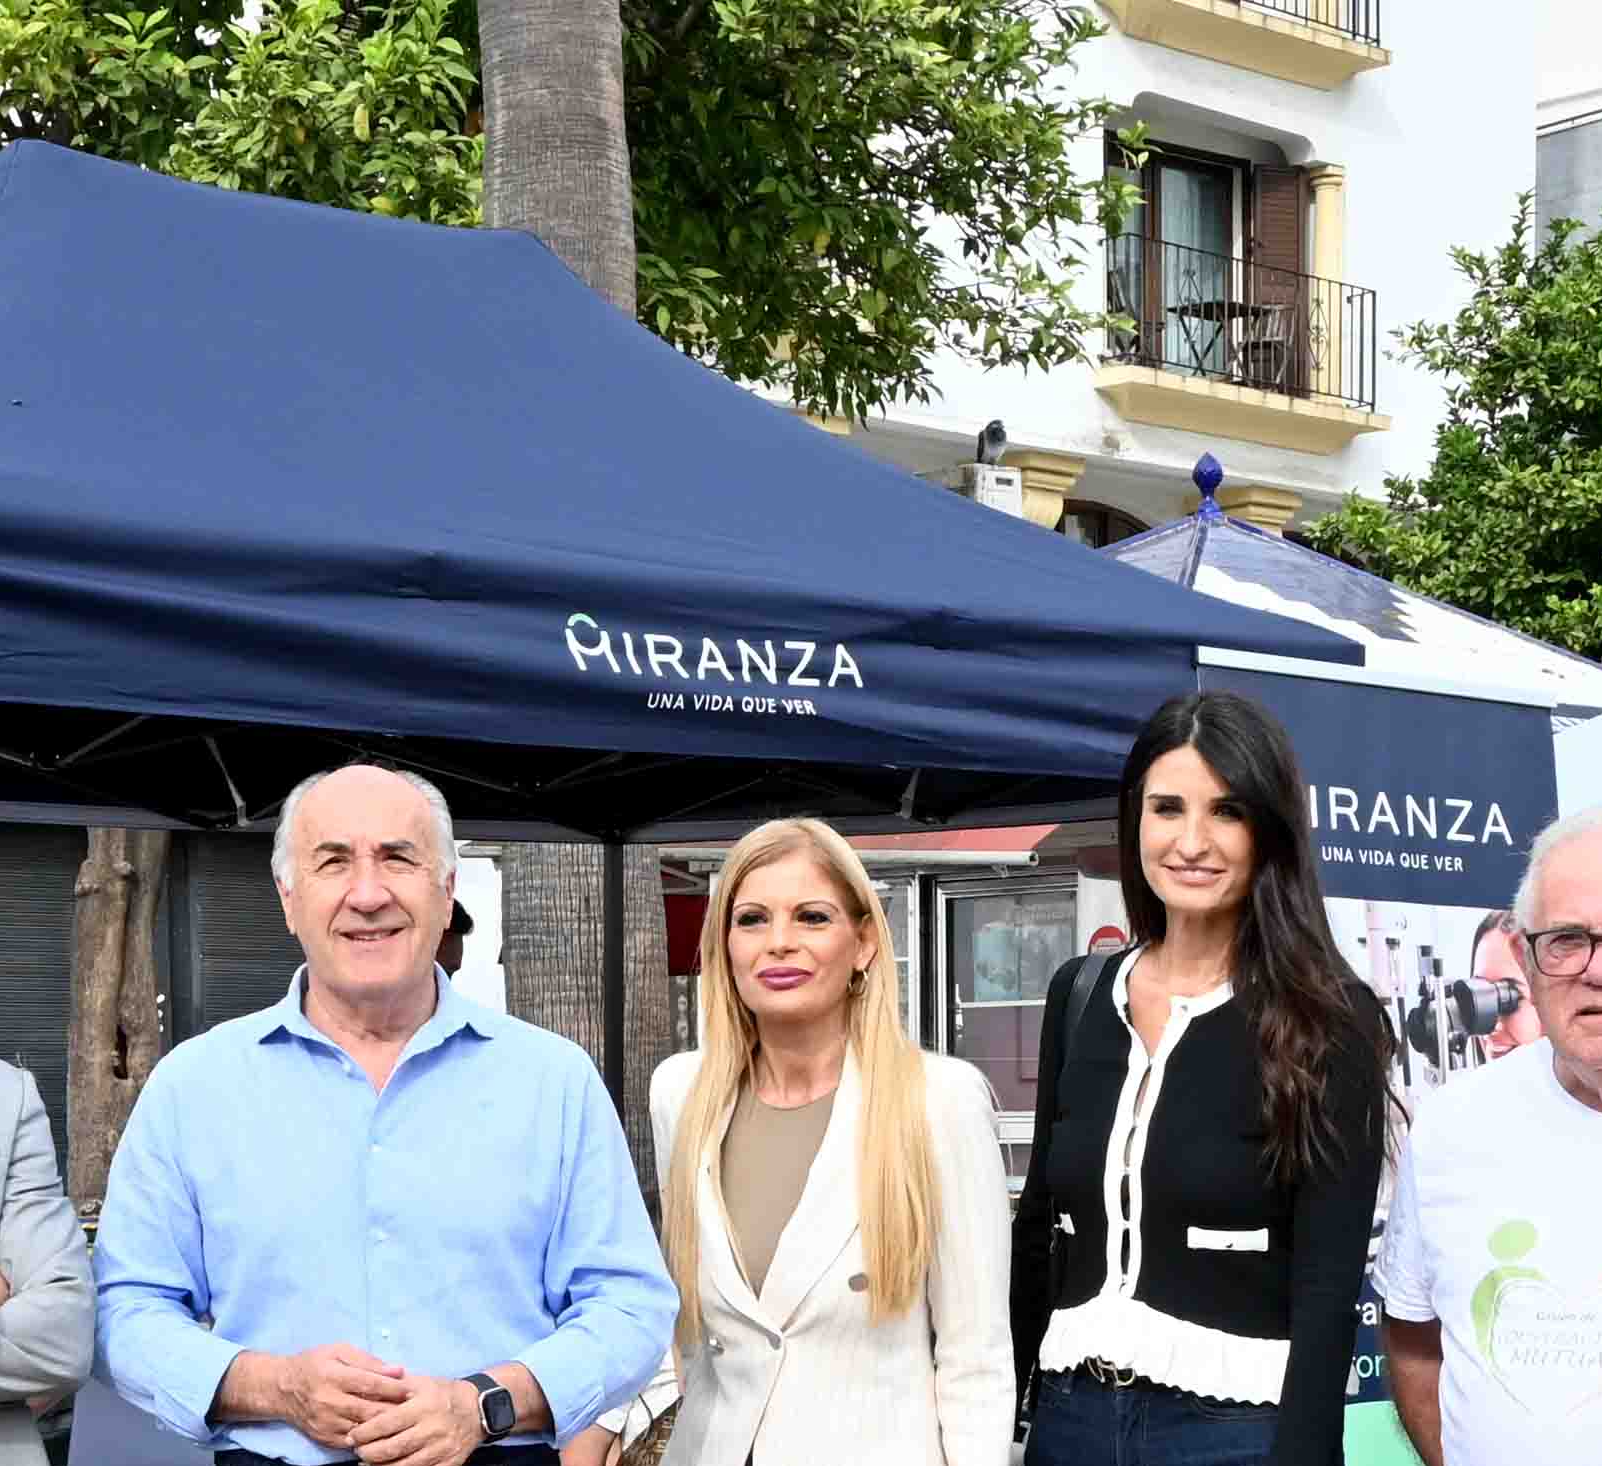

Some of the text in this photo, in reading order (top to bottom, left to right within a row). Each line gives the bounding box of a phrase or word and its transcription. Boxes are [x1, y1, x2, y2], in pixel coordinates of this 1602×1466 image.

[566, 613, 863, 688] MIRANZA
[647, 692, 817, 716] UNA VIDA QUE VER
[1309, 785, 1513, 846] IRANZA
[1322, 846, 1463, 872] UNA VIDA QUE VER
